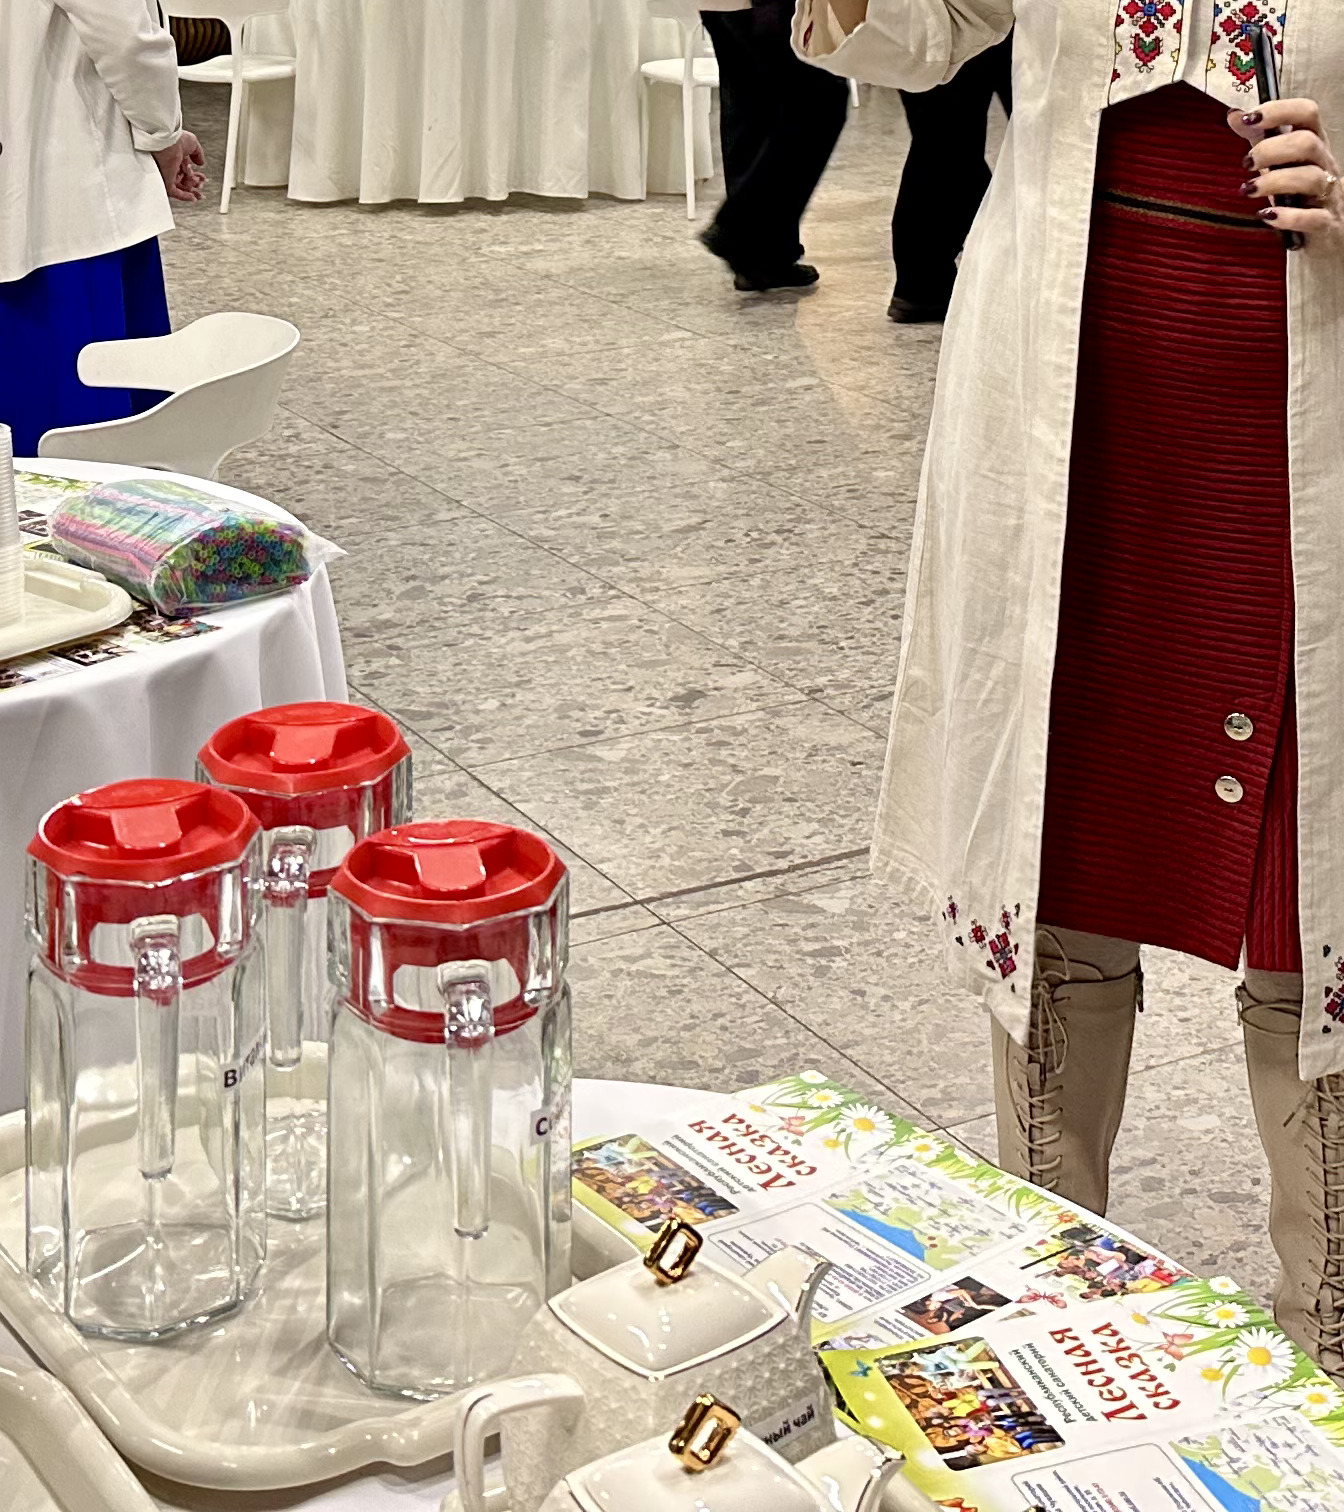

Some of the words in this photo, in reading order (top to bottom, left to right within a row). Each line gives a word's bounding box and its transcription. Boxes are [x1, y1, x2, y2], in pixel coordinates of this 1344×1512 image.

[687, 1119, 798, 1192] Лесная
[721, 1112, 818, 1177] сказка
[1009, 1348, 1078, 1425] Республиканский
[1022, 1342, 1066, 1388] санаторий
[1047, 1326, 1149, 1423] Лесная
[1090, 1321, 1182, 1411] сказка
[762, 1418, 792, 1445] ный
[792, 1403, 816, 1428] чай
[1061, 1388, 1099, 1423] детский
